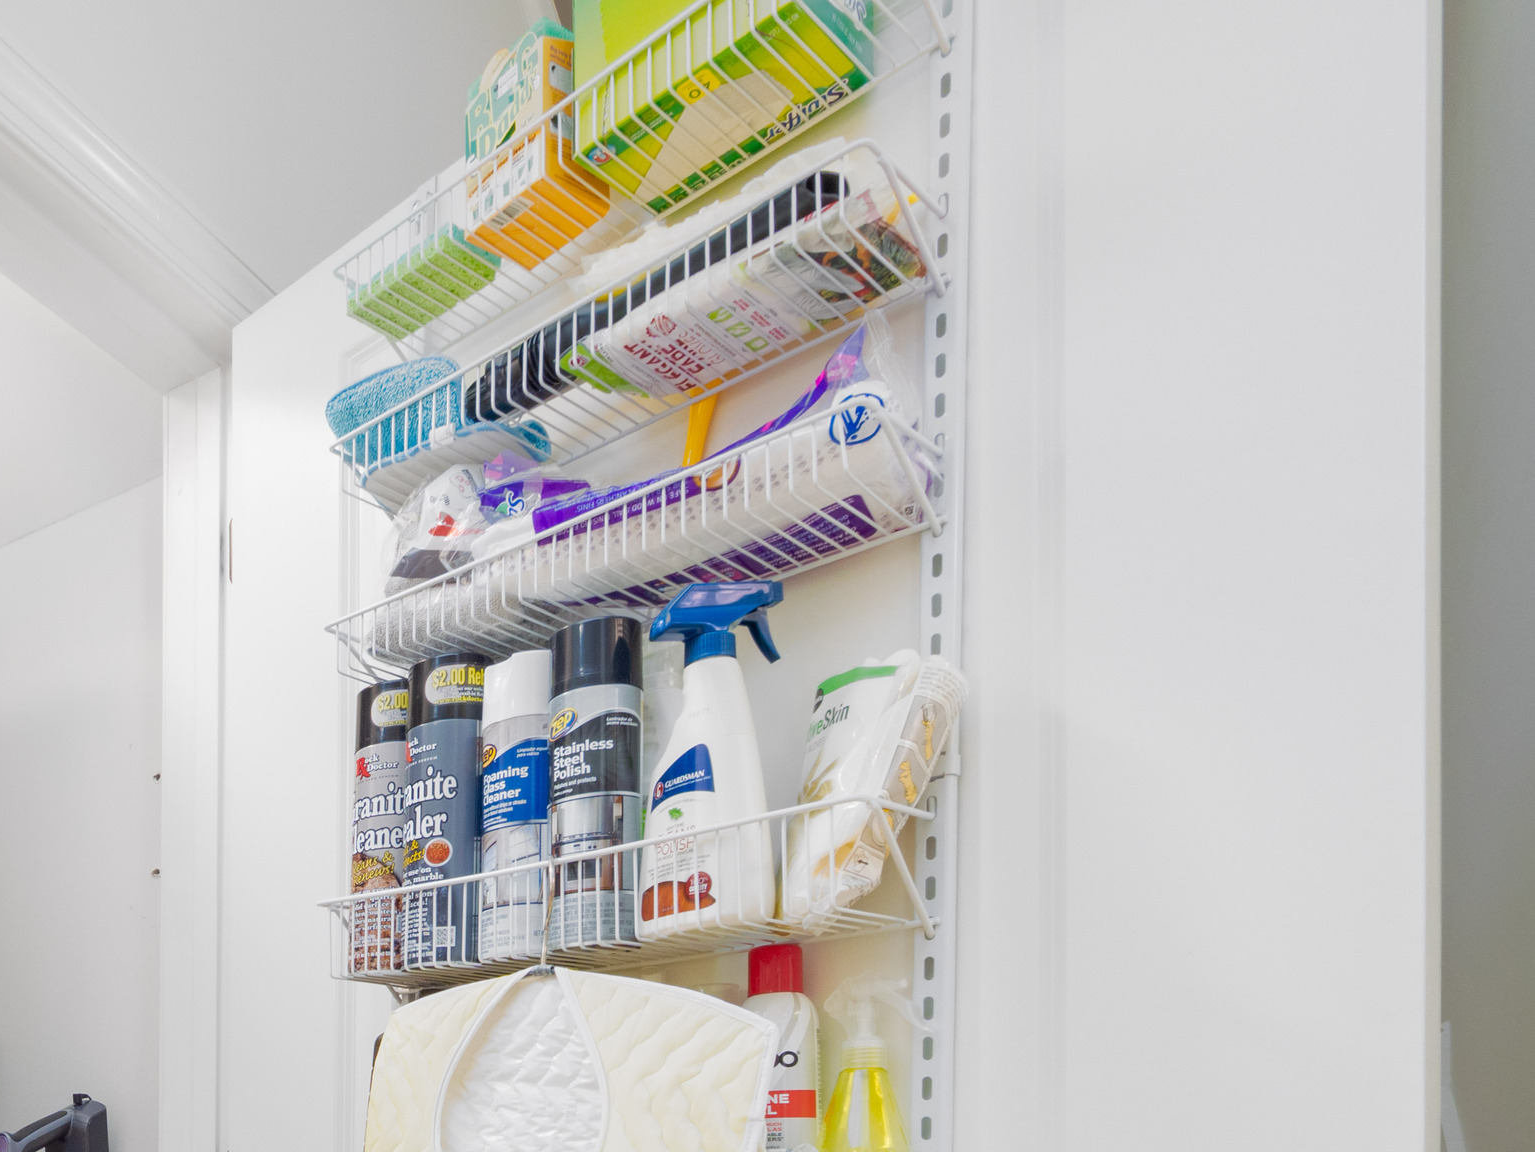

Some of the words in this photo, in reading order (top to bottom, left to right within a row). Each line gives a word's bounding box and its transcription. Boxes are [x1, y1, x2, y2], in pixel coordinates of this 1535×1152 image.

[623, 338, 703, 393] ELEGANT
[432, 667, 465, 689] $2.00
[377, 692, 408, 713] $2.00
[410, 743, 437, 757] Doctor
[554, 739, 614, 760] Stainless
[366, 761, 399, 773] Doctor
[554, 752, 584, 771] Steel
[483, 766, 529, 785] Foaming
[554, 762, 591, 782] Polish
[665, 769, 705, 789] GUARDSMAN
[404, 765, 458, 810] anite
[483, 781, 506, 796] Glass
[483, 788, 521, 806] Cleaner
[353, 781, 405, 823] ranit
[353, 823, 405, 855] leane
[382, 851, 394, 862] &
[354, 863, 394, 886] Renews!
[413, 872, 444, 882] marble
[767, 1093, 790, 1104] NE
[767, 1105, 777, 1115] L
